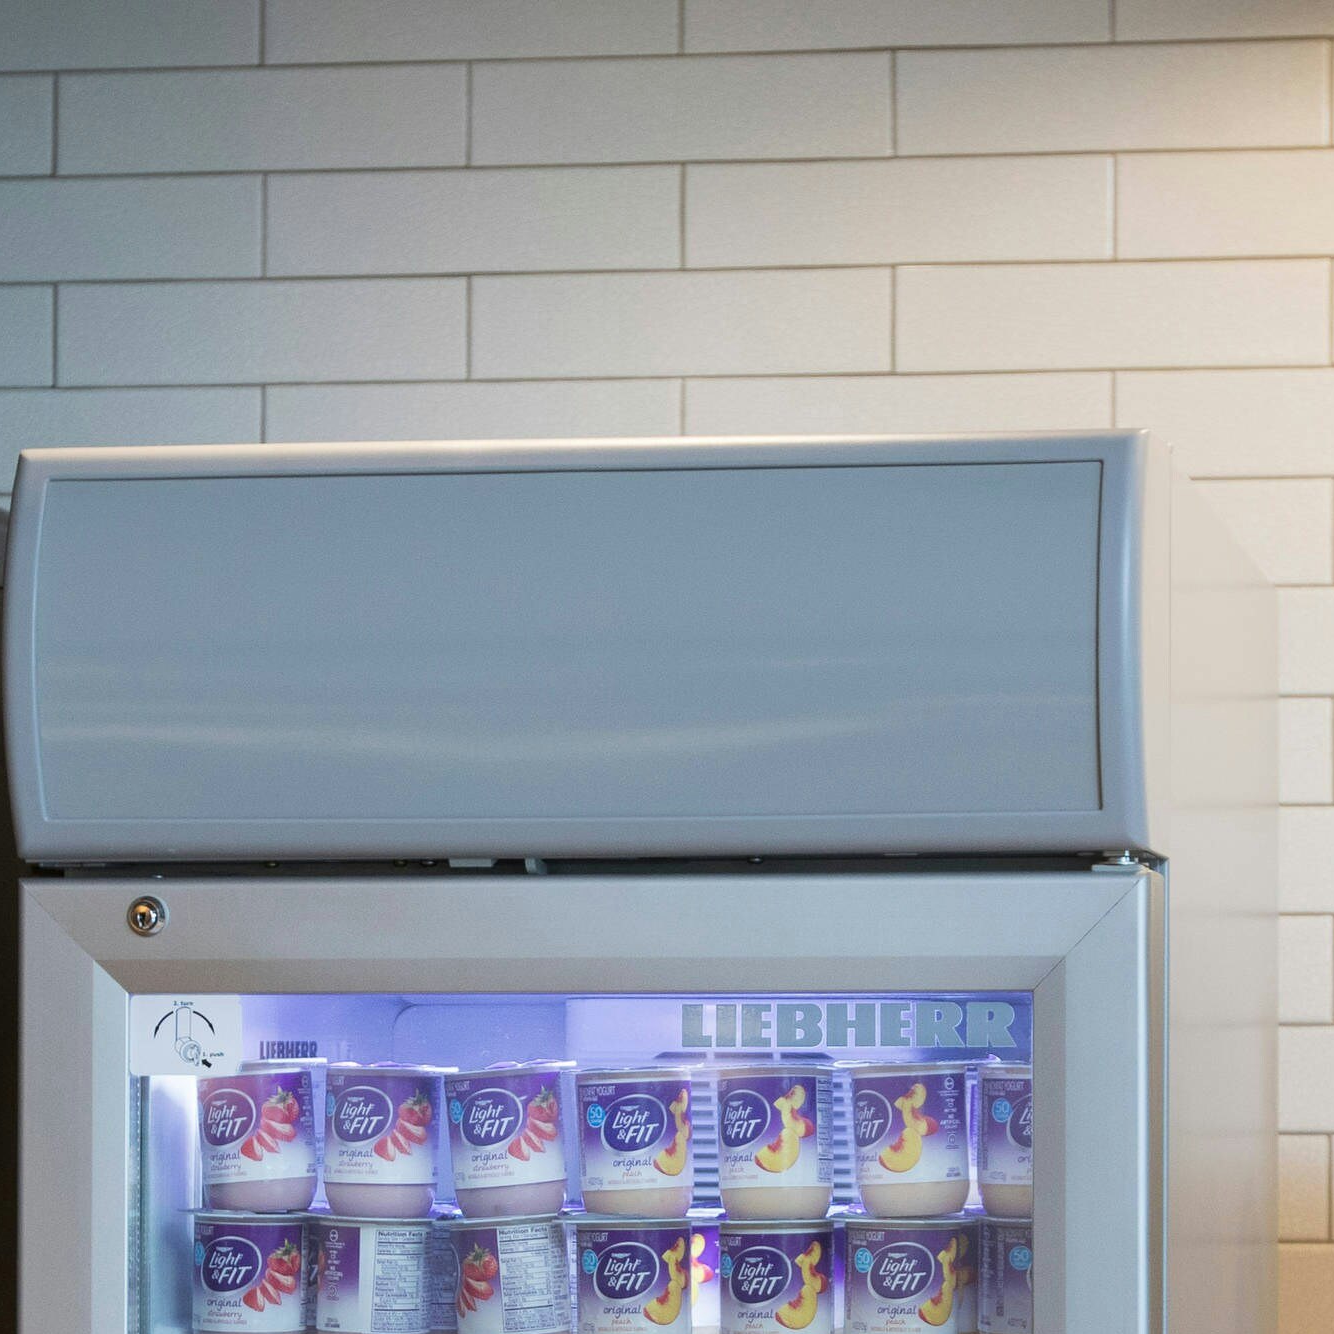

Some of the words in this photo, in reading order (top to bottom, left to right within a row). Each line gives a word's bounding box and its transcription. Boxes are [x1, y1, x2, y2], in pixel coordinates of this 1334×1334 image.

[681, 1002, 1016, 1048] LIEBHERR
[260, 1041, 317, 1059] LIEBHERR
[208, 1104, 235, 1123] Light
[340, 1102, 371, 1120] Light
[469, 1104, 501, 1124] Light
[724, 1106, 751, 1124] Light
[612, 1111, 649, 1129] Light
[339, 1149, 373, 1161] original
[472, 1153, 508, 1165] original
[613, 1156, 652, 1171] original
[209, 1251, 241, 1268] Light
[604, 1259, 638, 1275] Light
[879, 1258, 915, 1276] Light
[738, 1262, 771, 1281] Light
[207, 1298, 242, 1311] original
[604, 1306, 641, 1319] original
[877, 1305, 916, 1319] original
[738, 1310, 773, 1324] original
